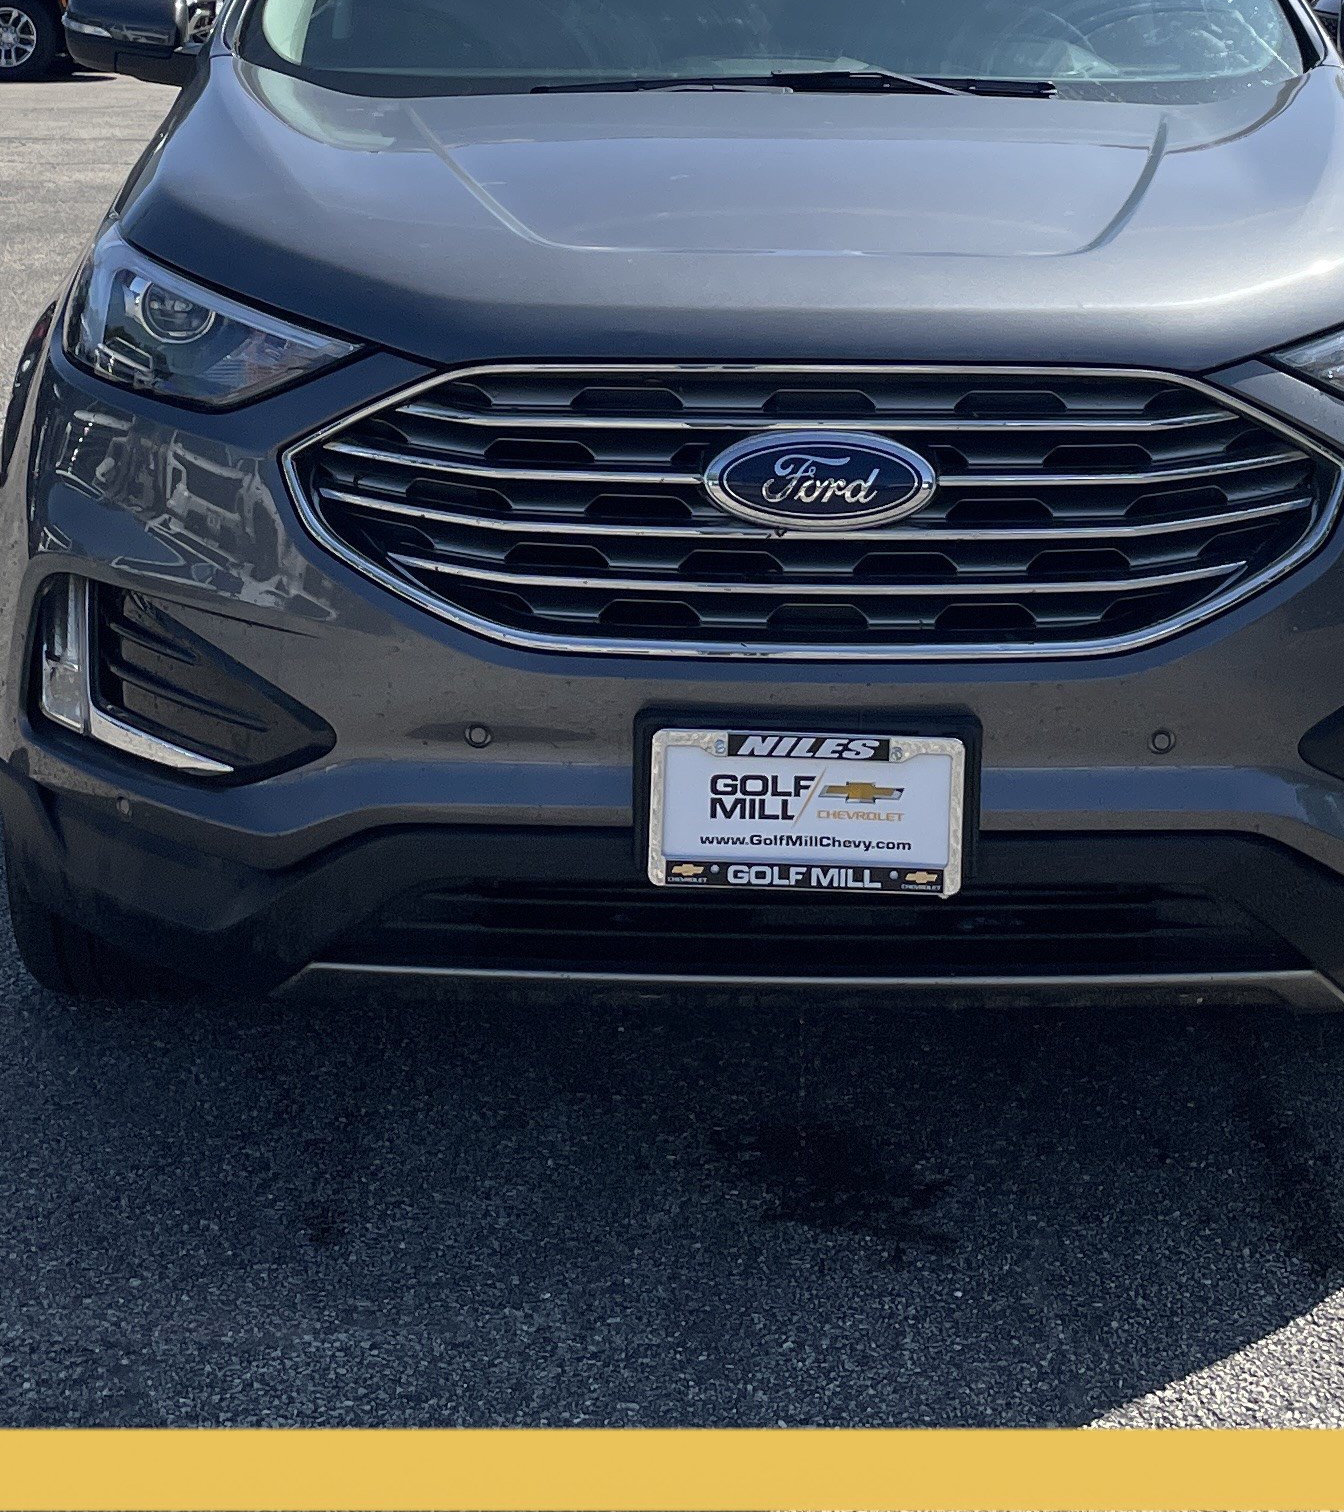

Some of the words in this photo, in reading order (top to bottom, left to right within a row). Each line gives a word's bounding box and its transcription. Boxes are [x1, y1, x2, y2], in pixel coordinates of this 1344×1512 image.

[761, 453, 880, 504] Ford
[737, 735, 880, 760] NILES
[710, 773, 817, 798] GOLF
[710, 797, 795, 821] MILL
[816, 809, 905, 822] CHEVROLET
[700, 833, 912, 852] www.GolfMillChevy.com
[727, 864, 807, 886] GOLF
[810, 867, 882, 889] MILL
